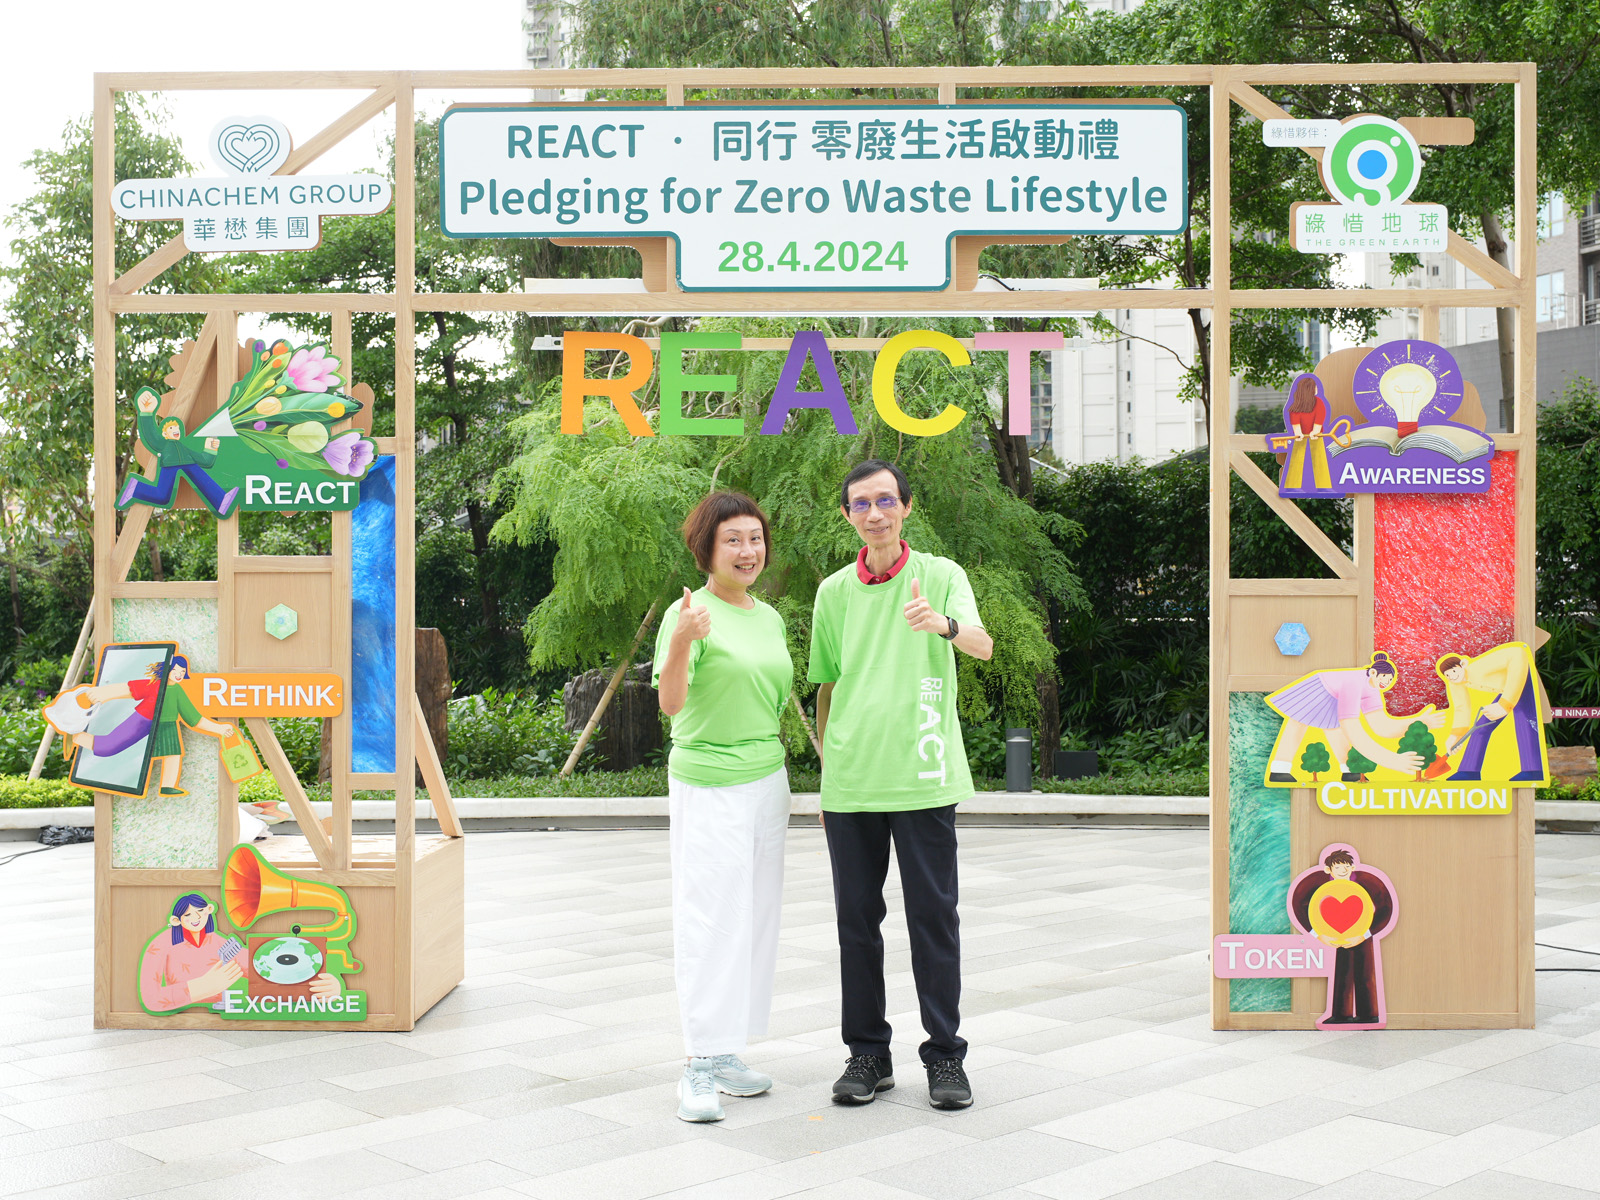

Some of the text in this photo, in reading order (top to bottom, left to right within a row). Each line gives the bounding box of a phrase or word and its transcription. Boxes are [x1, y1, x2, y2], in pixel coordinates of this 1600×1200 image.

[508, 123, 645, 159] REACT
[713, 119, 798, 162] 同行
[811, 118, 1120, 162] 零廢生活啟動禮
[119, 184, 382, 209] CHINACHEM GROUP
[460, 175, 1168, 225] Pledging for Zero Waste Lifestyle
[193, 216, 309, 241] 華懋集團
[1306, 238, 1440, 247] THE GREEN EARTH
[717, 241, 909, 272] 28.4.2024
[560, 329, 1064, 437] REACT
[1565, 709, 1589, 717] NINA
